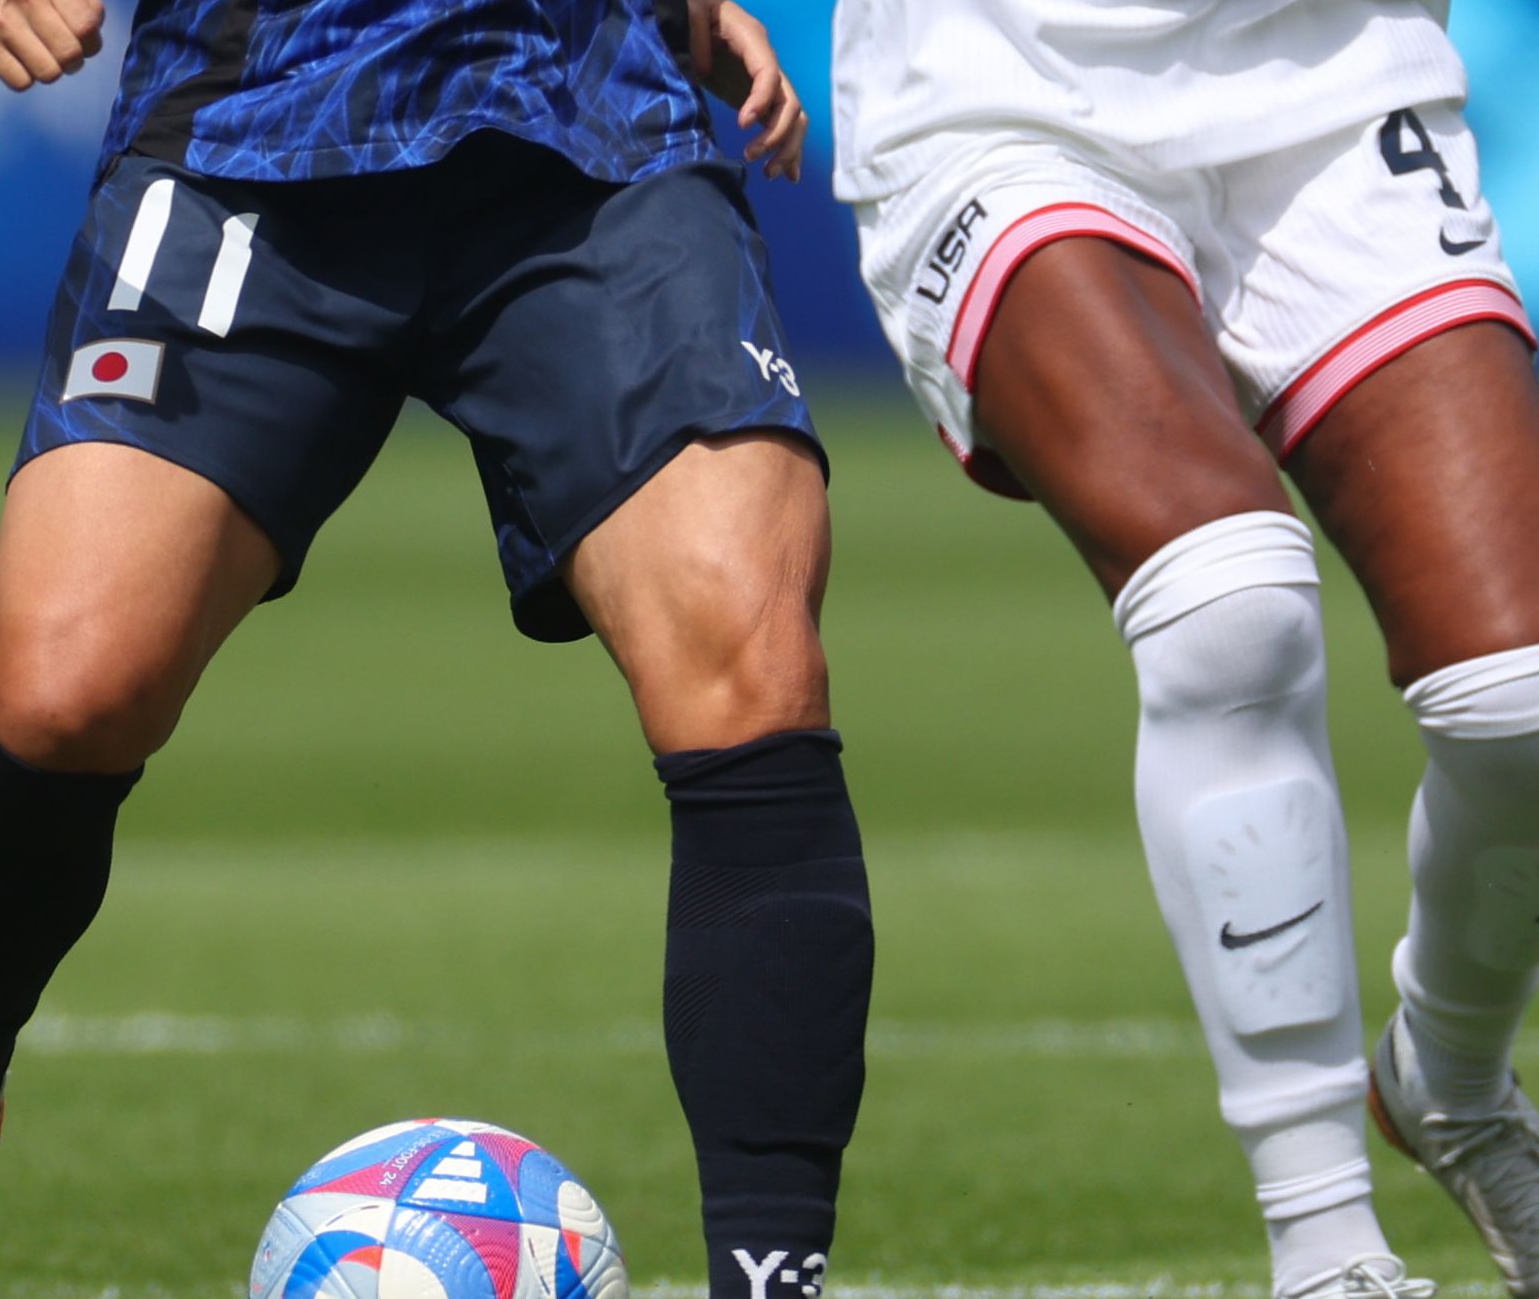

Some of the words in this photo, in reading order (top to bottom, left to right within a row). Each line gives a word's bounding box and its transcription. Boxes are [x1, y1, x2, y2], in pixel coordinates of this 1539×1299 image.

[1379, 107, 1469, 211] 4
[107, 179, 260, 338] 11
[916, 198, 988, 305] USA
[740, 340, 801, 397] Y-3
[379, 1171, 397, 1187] 24
